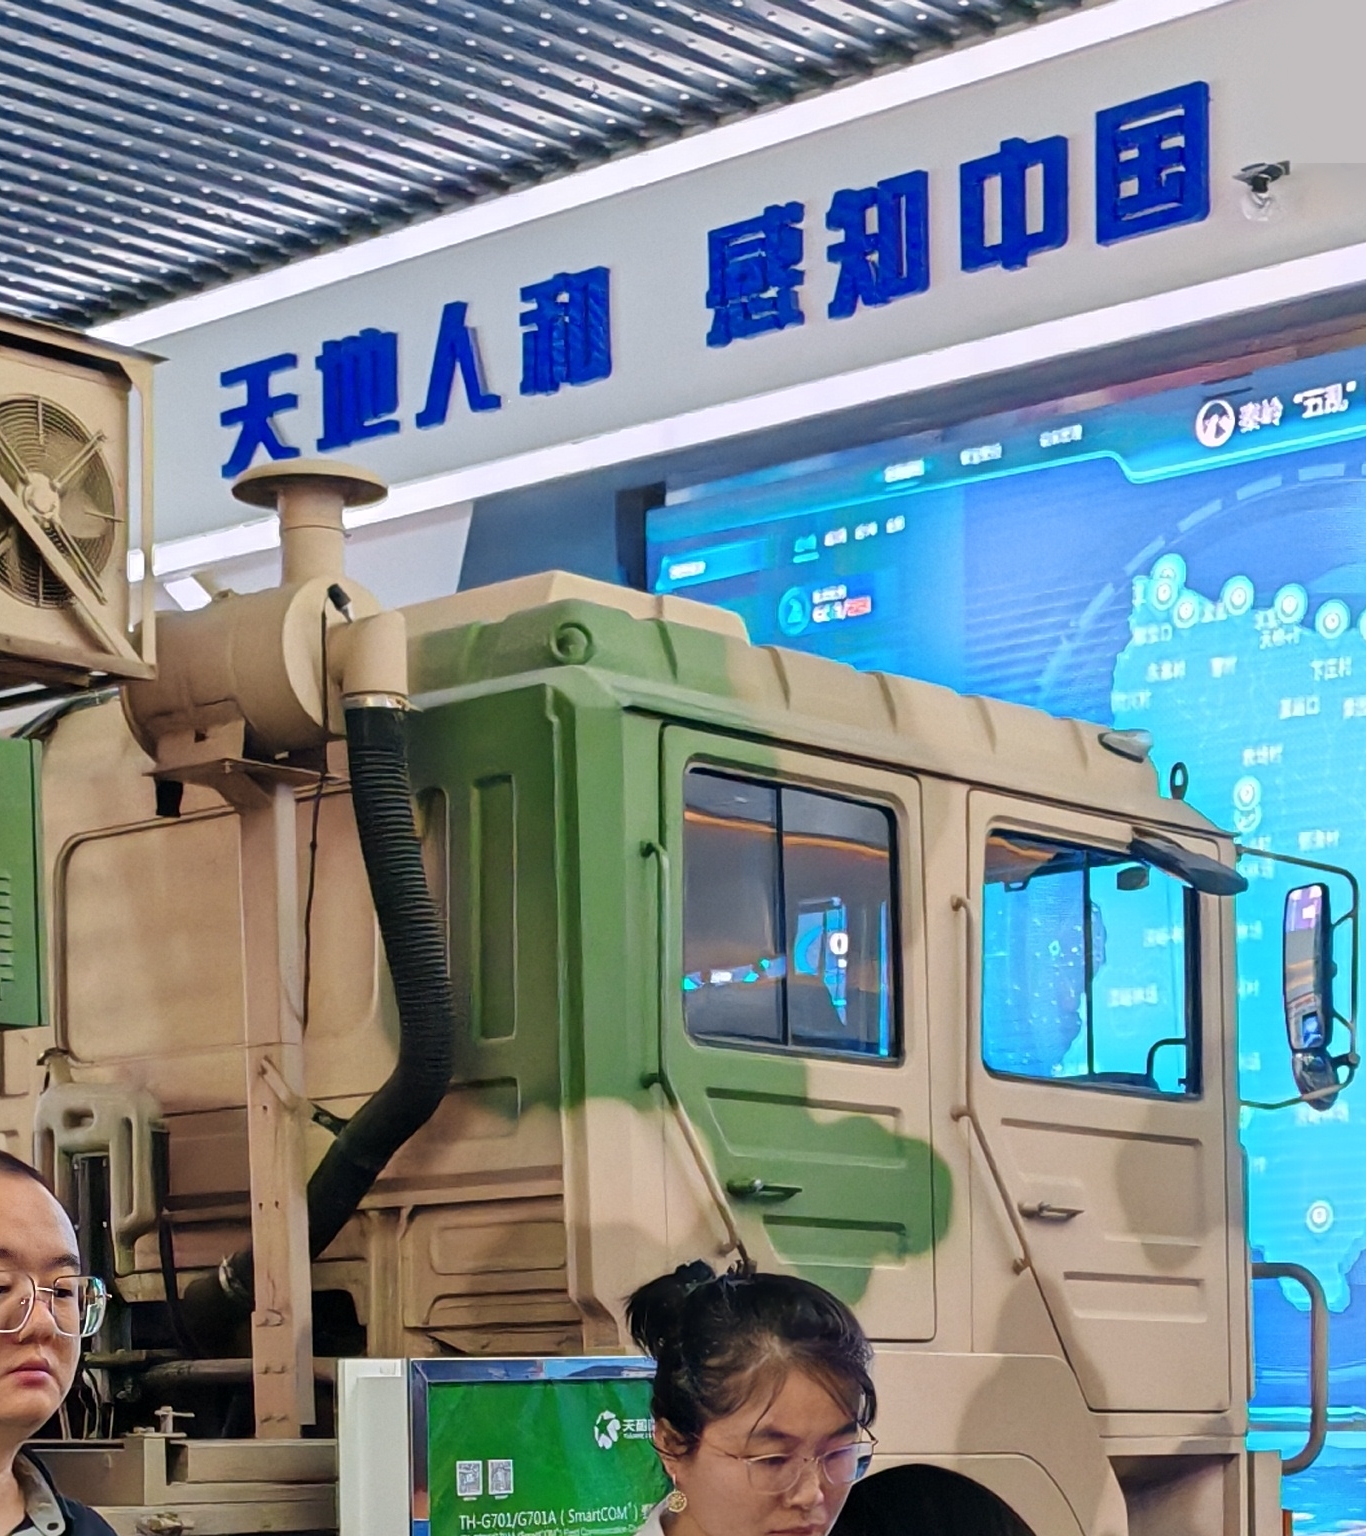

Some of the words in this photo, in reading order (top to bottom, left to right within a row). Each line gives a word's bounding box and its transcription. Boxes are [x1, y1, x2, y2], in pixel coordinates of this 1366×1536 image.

[220, 265, 612, 477] 天地人和
[705, 80, 1210, 348] 感知中国
[459, 1509, 557, 1530] TH-G701/G701A
